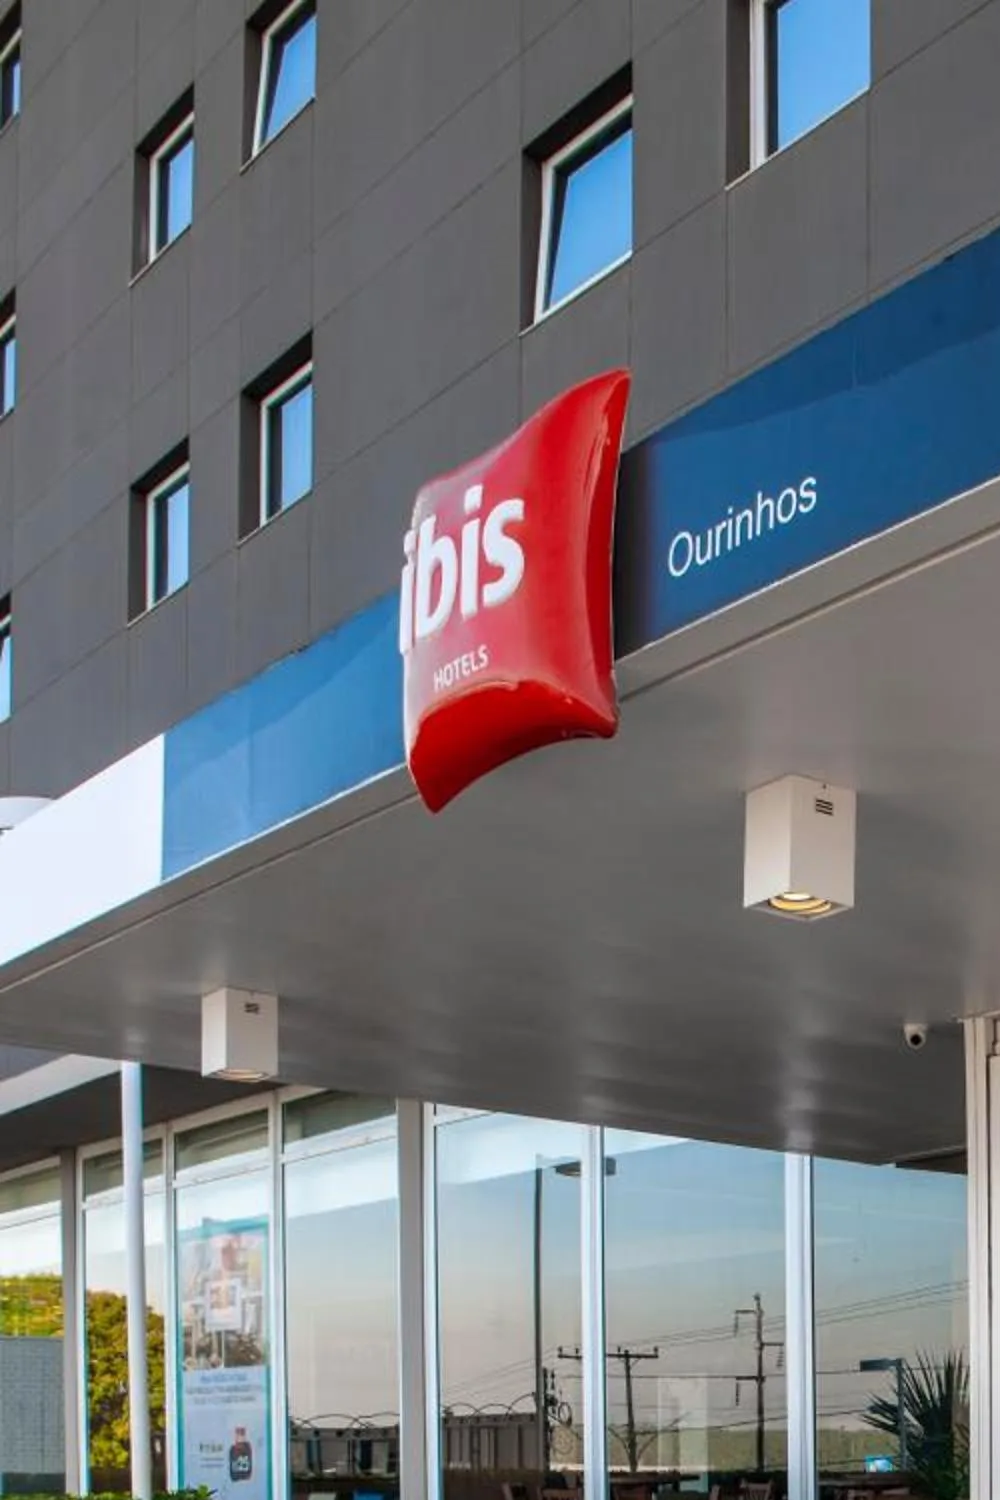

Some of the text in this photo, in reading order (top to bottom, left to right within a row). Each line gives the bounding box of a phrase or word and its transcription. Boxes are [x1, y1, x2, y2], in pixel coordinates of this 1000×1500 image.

[400, 484, 525, 655] ibis
[667, 476, 818, 578] Ourinhos
[432, 644, 489, 692] HOTELS
